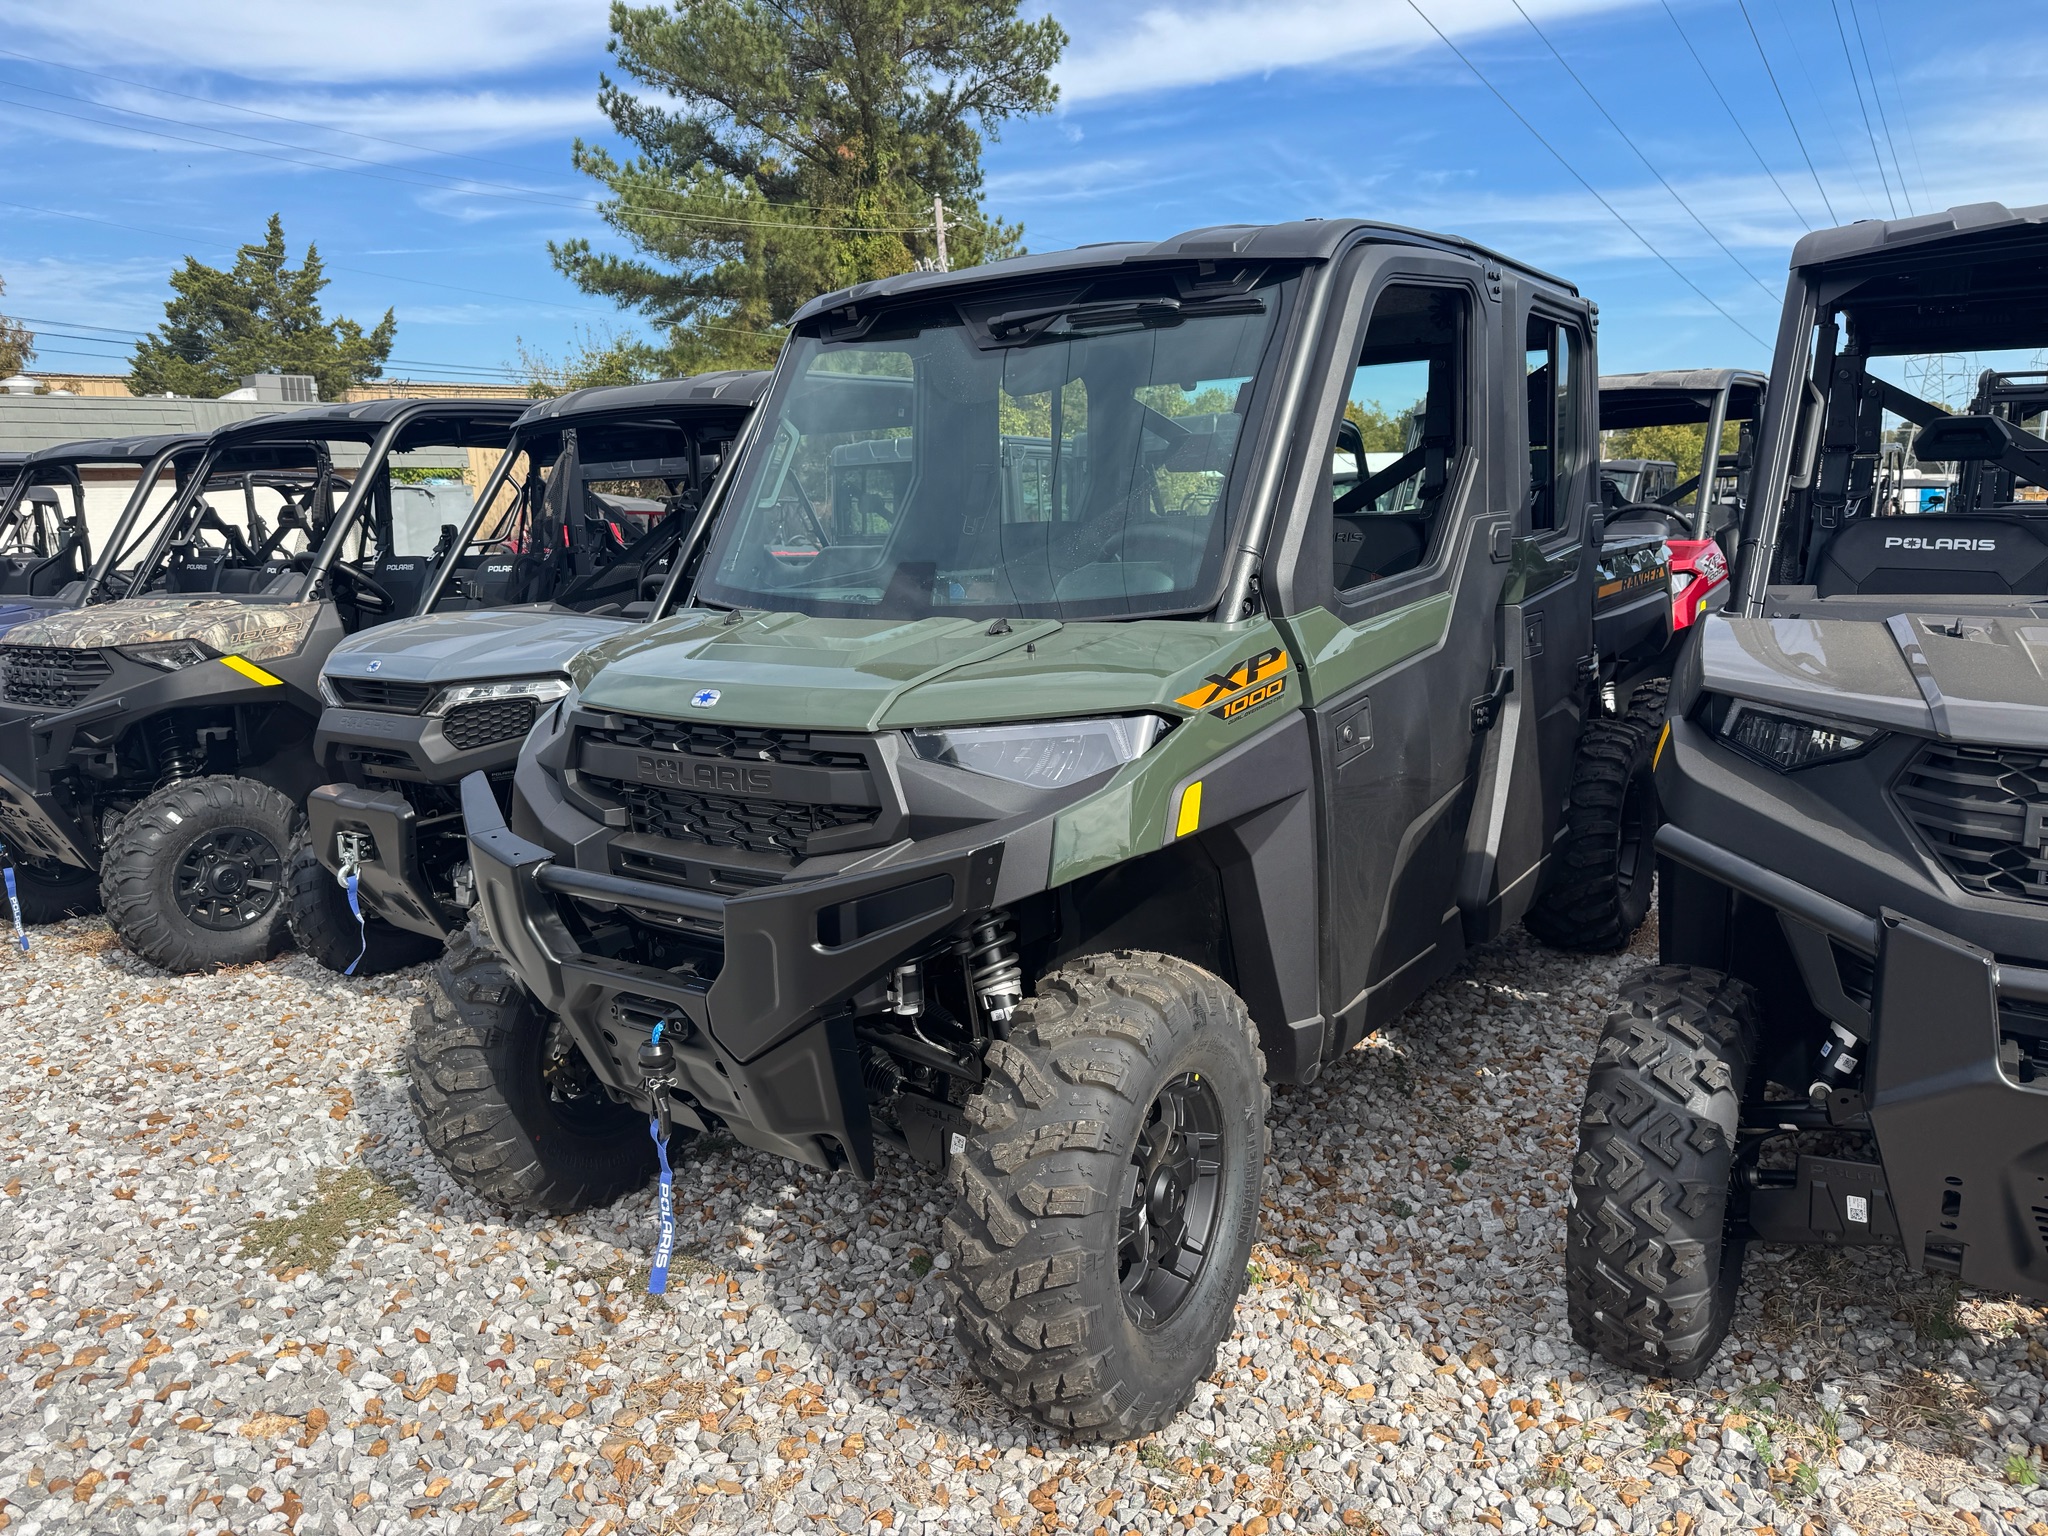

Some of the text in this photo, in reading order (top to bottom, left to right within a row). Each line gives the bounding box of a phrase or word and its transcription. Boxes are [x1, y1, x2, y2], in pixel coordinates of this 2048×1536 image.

[1885, 537, 1996, 551] POLARIS
[487, 565, 513, 573] POLAR
[1622, 568, 1661, 590] RANGER
[231, 622, 304, 643] 1000
[1201, 646, 1282, 707] XP
[1223, 679, 1283, 718] 1000
[338, 715, 398, 733] POLARIS
[637, 755, 773, 794] POLARIS
[10, 896, 25, 938] POLARIS
[655, 1183, 673, 1268] POLARIS
